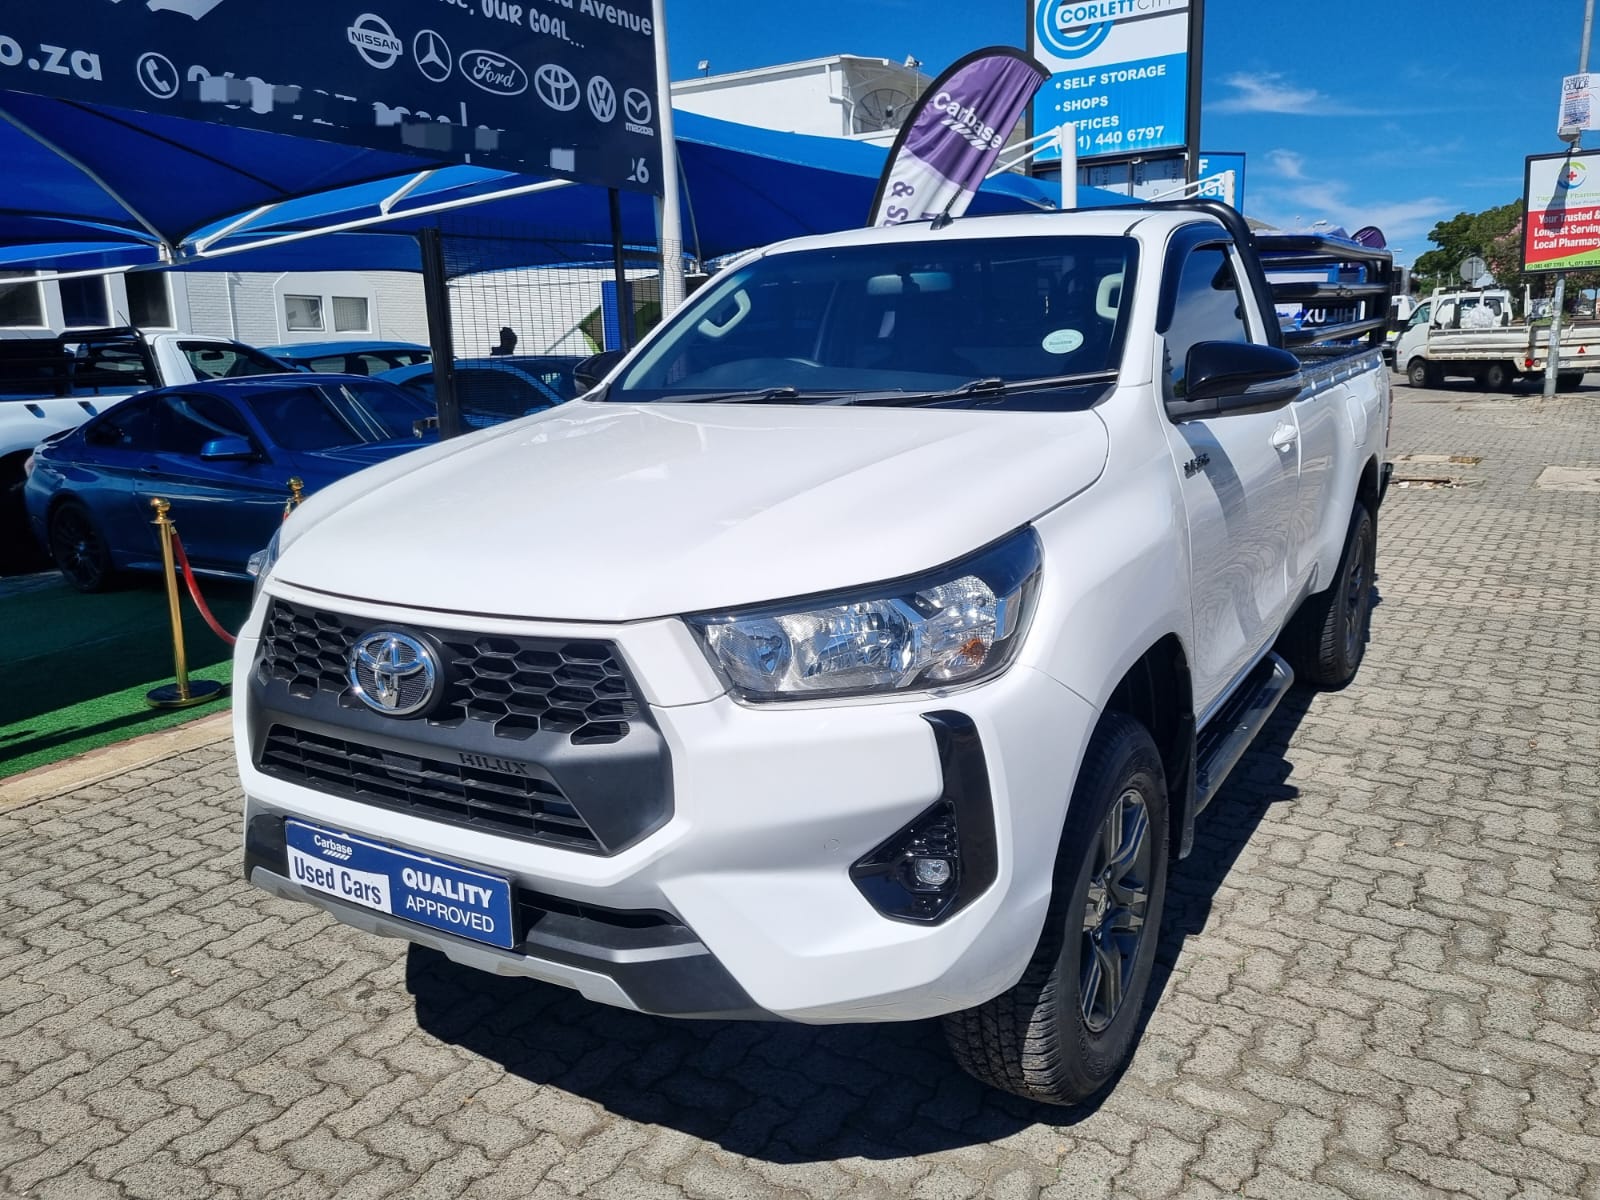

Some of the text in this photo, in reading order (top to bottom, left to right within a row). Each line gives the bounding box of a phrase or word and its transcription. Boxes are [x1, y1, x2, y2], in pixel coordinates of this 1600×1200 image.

[580, 0, 653, 36] Avenue
[1060, 0, 1135, 24] CORLETT
[351, 31, 400, 52] NISSAN
[473, 55, 515, 88] Ford
[1063, 64, 1167, 90] SELF STORAGE
[1062, 96, 1109, 112] SHOPS
[933, 92, 1003, 149] Carbase
[1095, 130, 1123, 146] 440
[1127, 125, 1165, 142] 6797
[1538, 214, 1559, 224] Your
[1560, 211, 1593, 223] Trusted
[1534, 225, 1569, 238] Longest
[1533, 239, 1558, 250] Local
[458, 752, 529, 775] HILUX
[314, 834, 353, 856] Carbase
[294, 855, 382, 905] Used Cars
[402, 867, 493, 909] QUALITY
[406, 894, 495, 933] APPROVED
